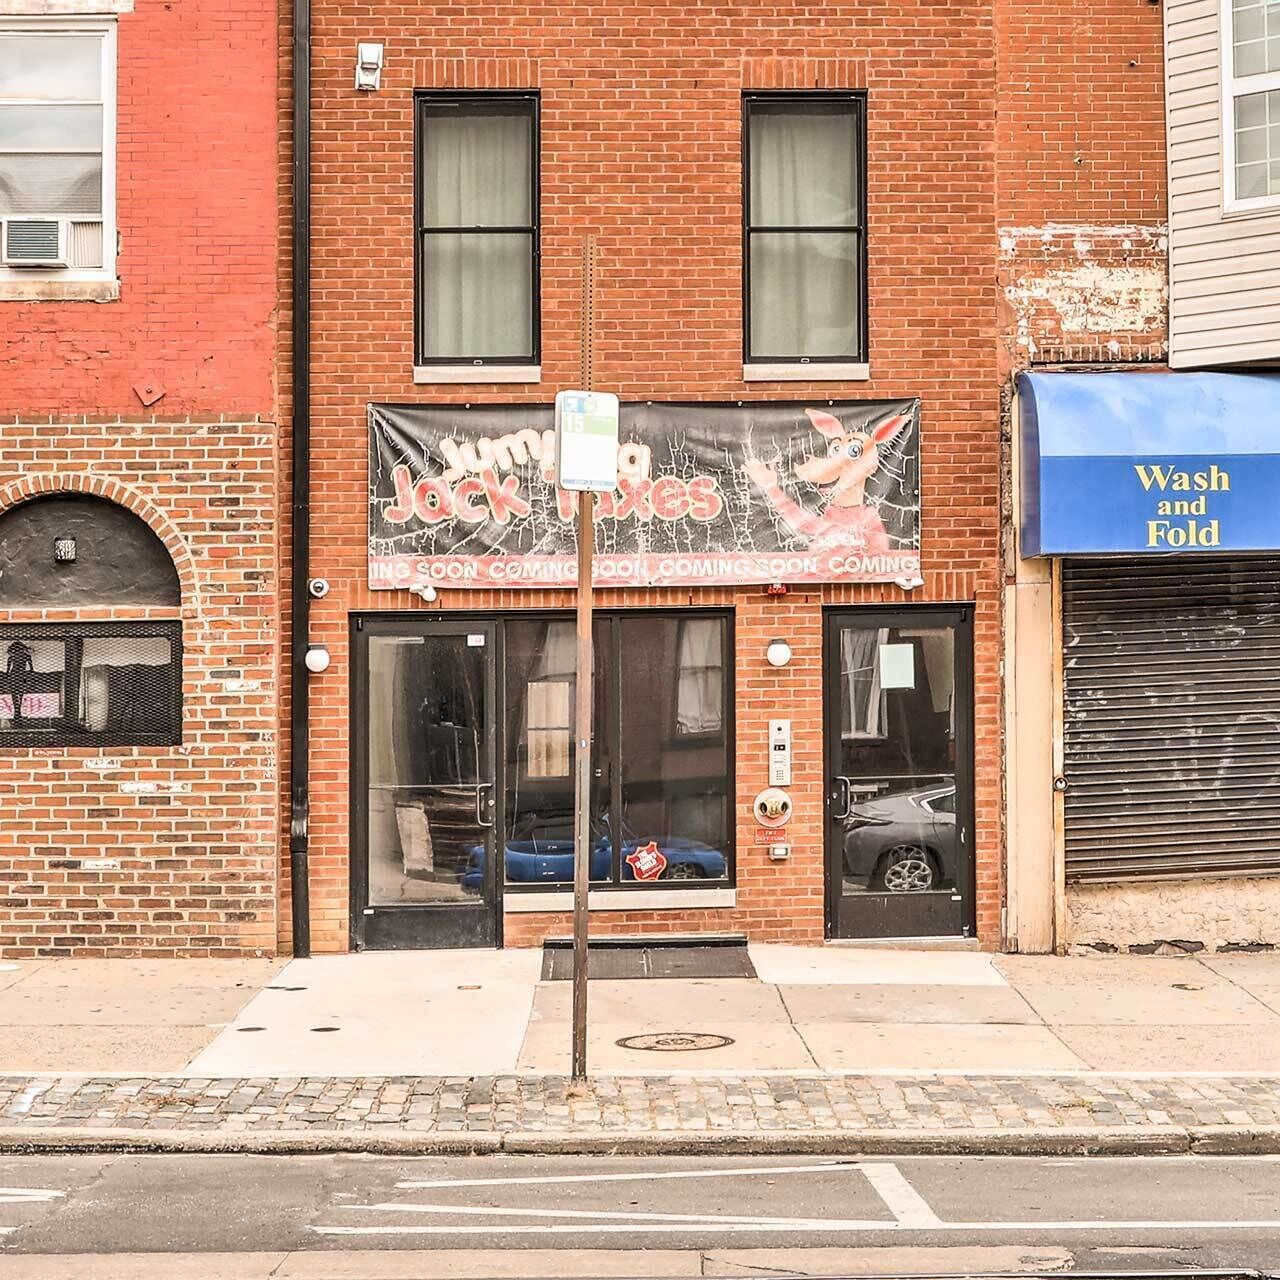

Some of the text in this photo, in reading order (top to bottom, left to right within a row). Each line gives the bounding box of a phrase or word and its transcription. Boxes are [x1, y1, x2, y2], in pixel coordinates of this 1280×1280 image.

[566, 414, 585, 433] 15
[439, 429, 652, 484] Jumg
[1134, 463, 1231, 493] Wash
[384, 464, 532, 525] Jack
[1157, 495, 1207, 517] and
[1146, 519, 1220, 549] Fold
[370, 562, 410, 579] ING
[416, 561, 478, 579] SOON
[488, 561, 579, 579] COMING
[659, 558, 751, 577] COMING
[753, 557, 817, 577] SOON
[828, 555, 917, 575] COMING
